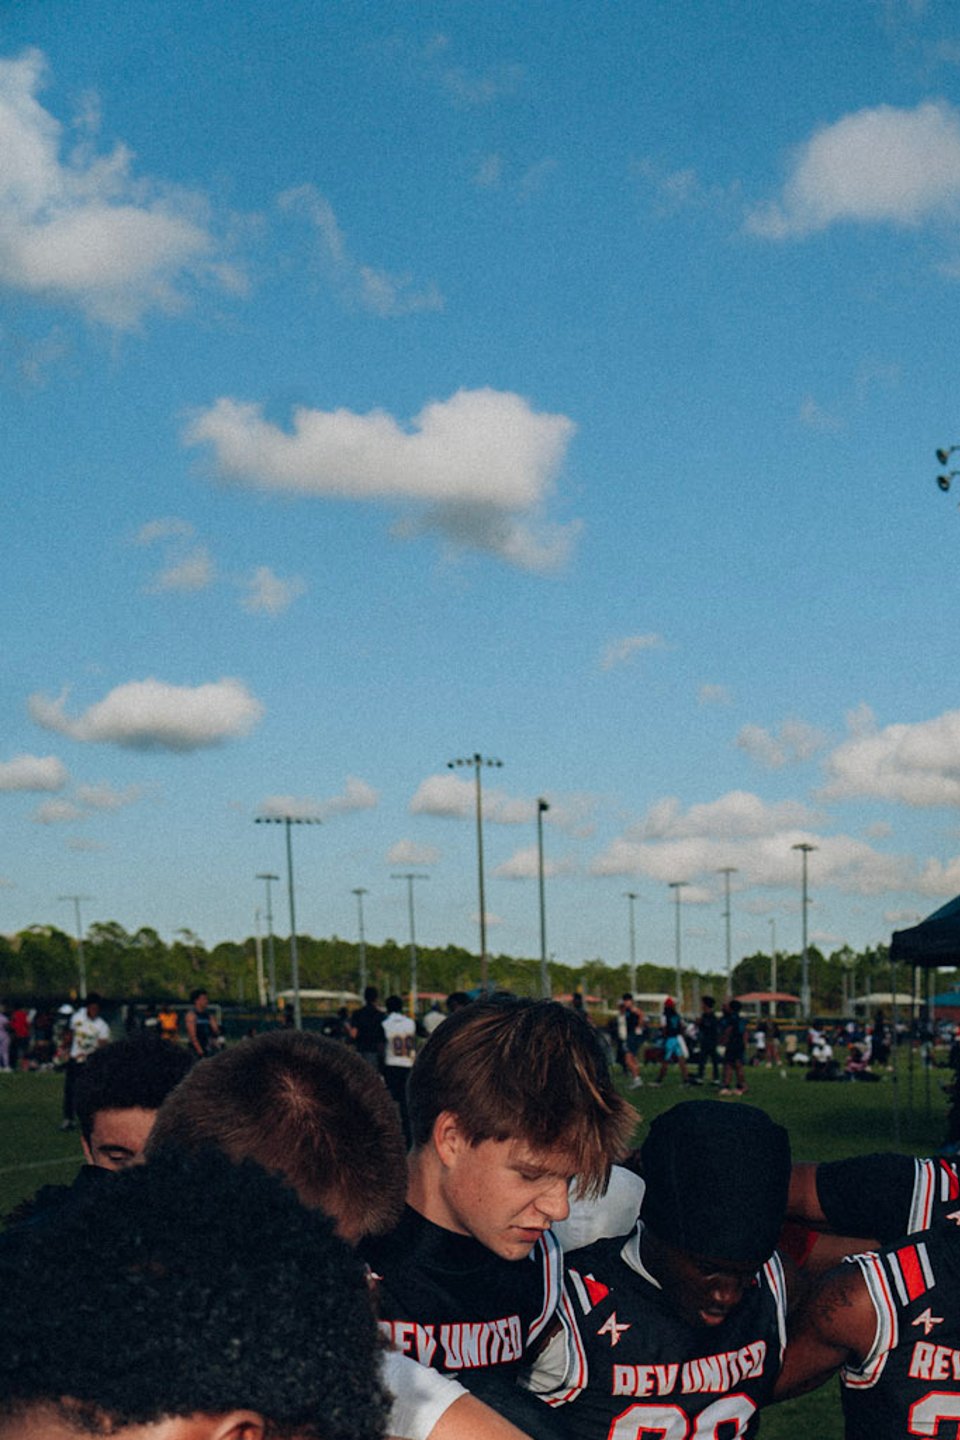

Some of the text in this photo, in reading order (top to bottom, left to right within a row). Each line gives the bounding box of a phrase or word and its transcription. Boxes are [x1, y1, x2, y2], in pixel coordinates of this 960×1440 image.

[440, 1313, 523, 1370] UNITED
[611, 1339, 767, 1397] REV UNITED
